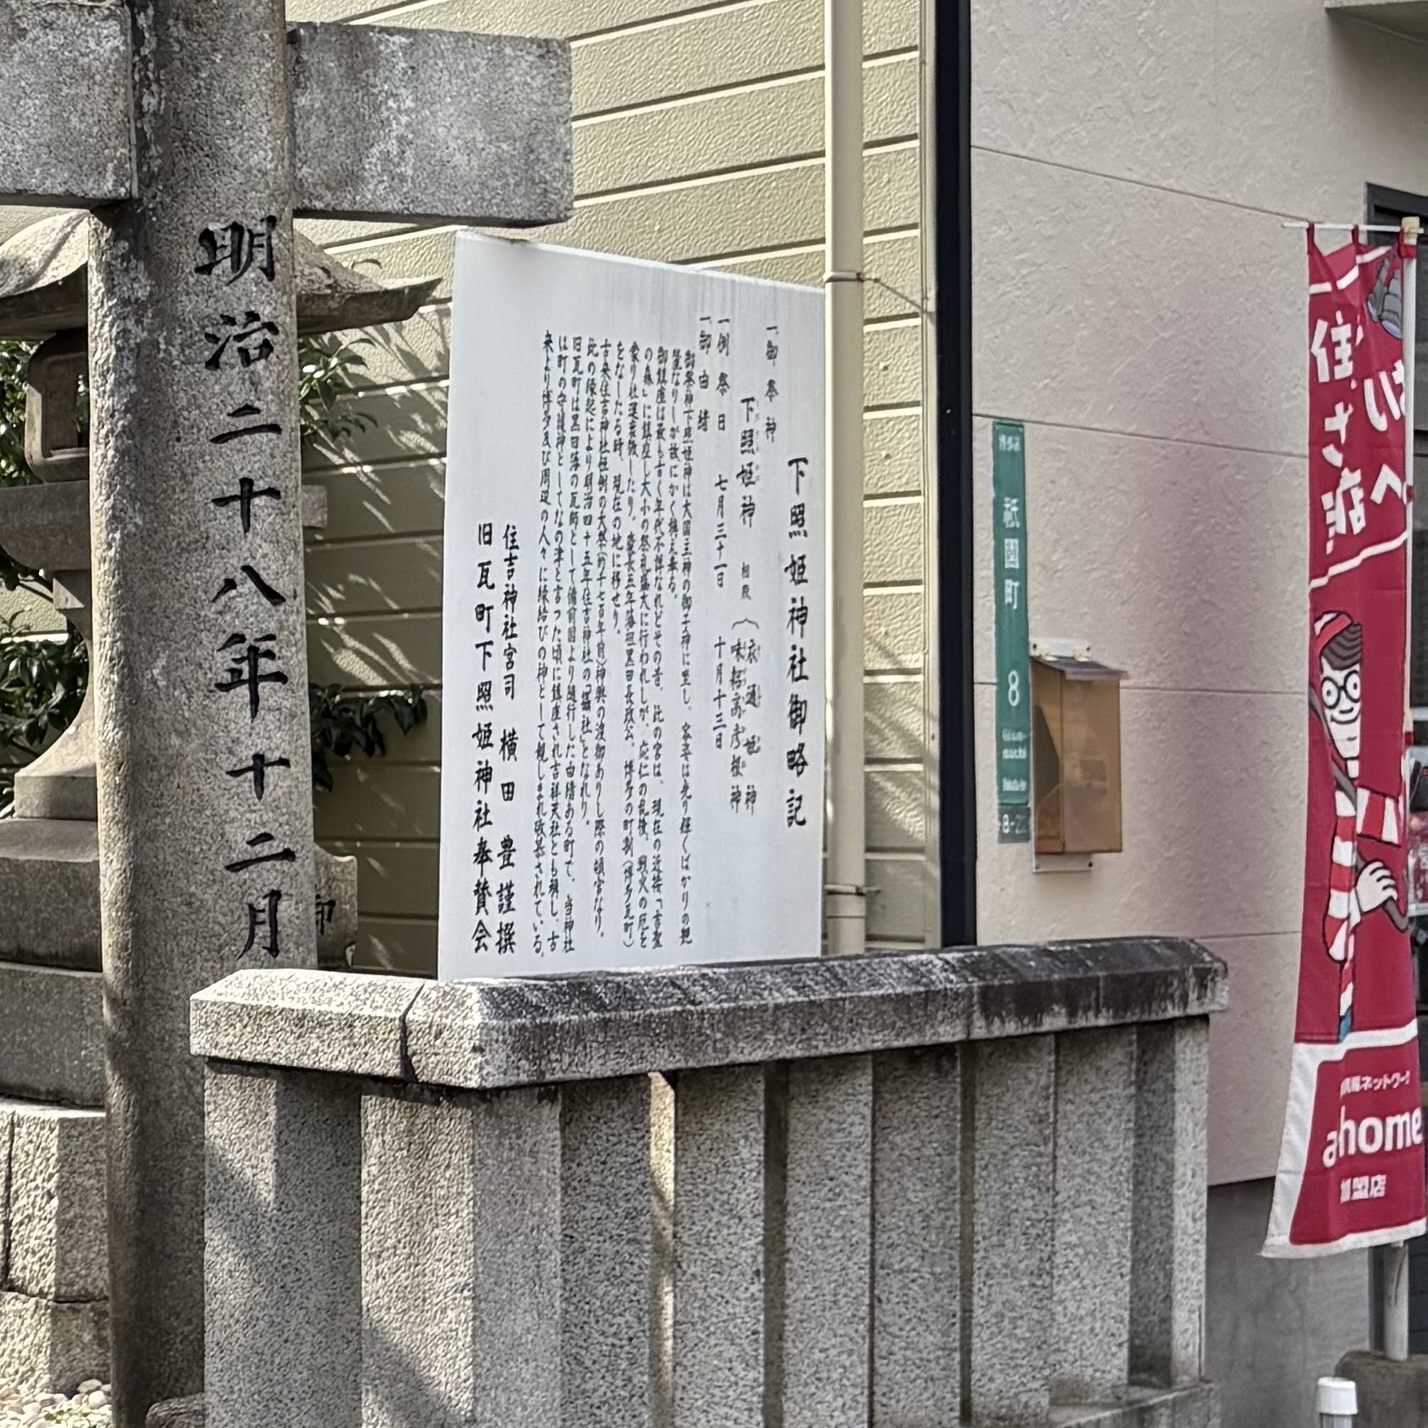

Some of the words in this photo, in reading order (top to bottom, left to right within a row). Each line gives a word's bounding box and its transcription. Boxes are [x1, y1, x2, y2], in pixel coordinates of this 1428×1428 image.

[196, 215, 295, 959] 明治二十八年十二月
[471, 521, 496, 954] 旧瓦町下照姫神社奉賛会
[501, 523, 520, 700] 住吉神社宮司
[1007, 670, 1020, 708] 8
